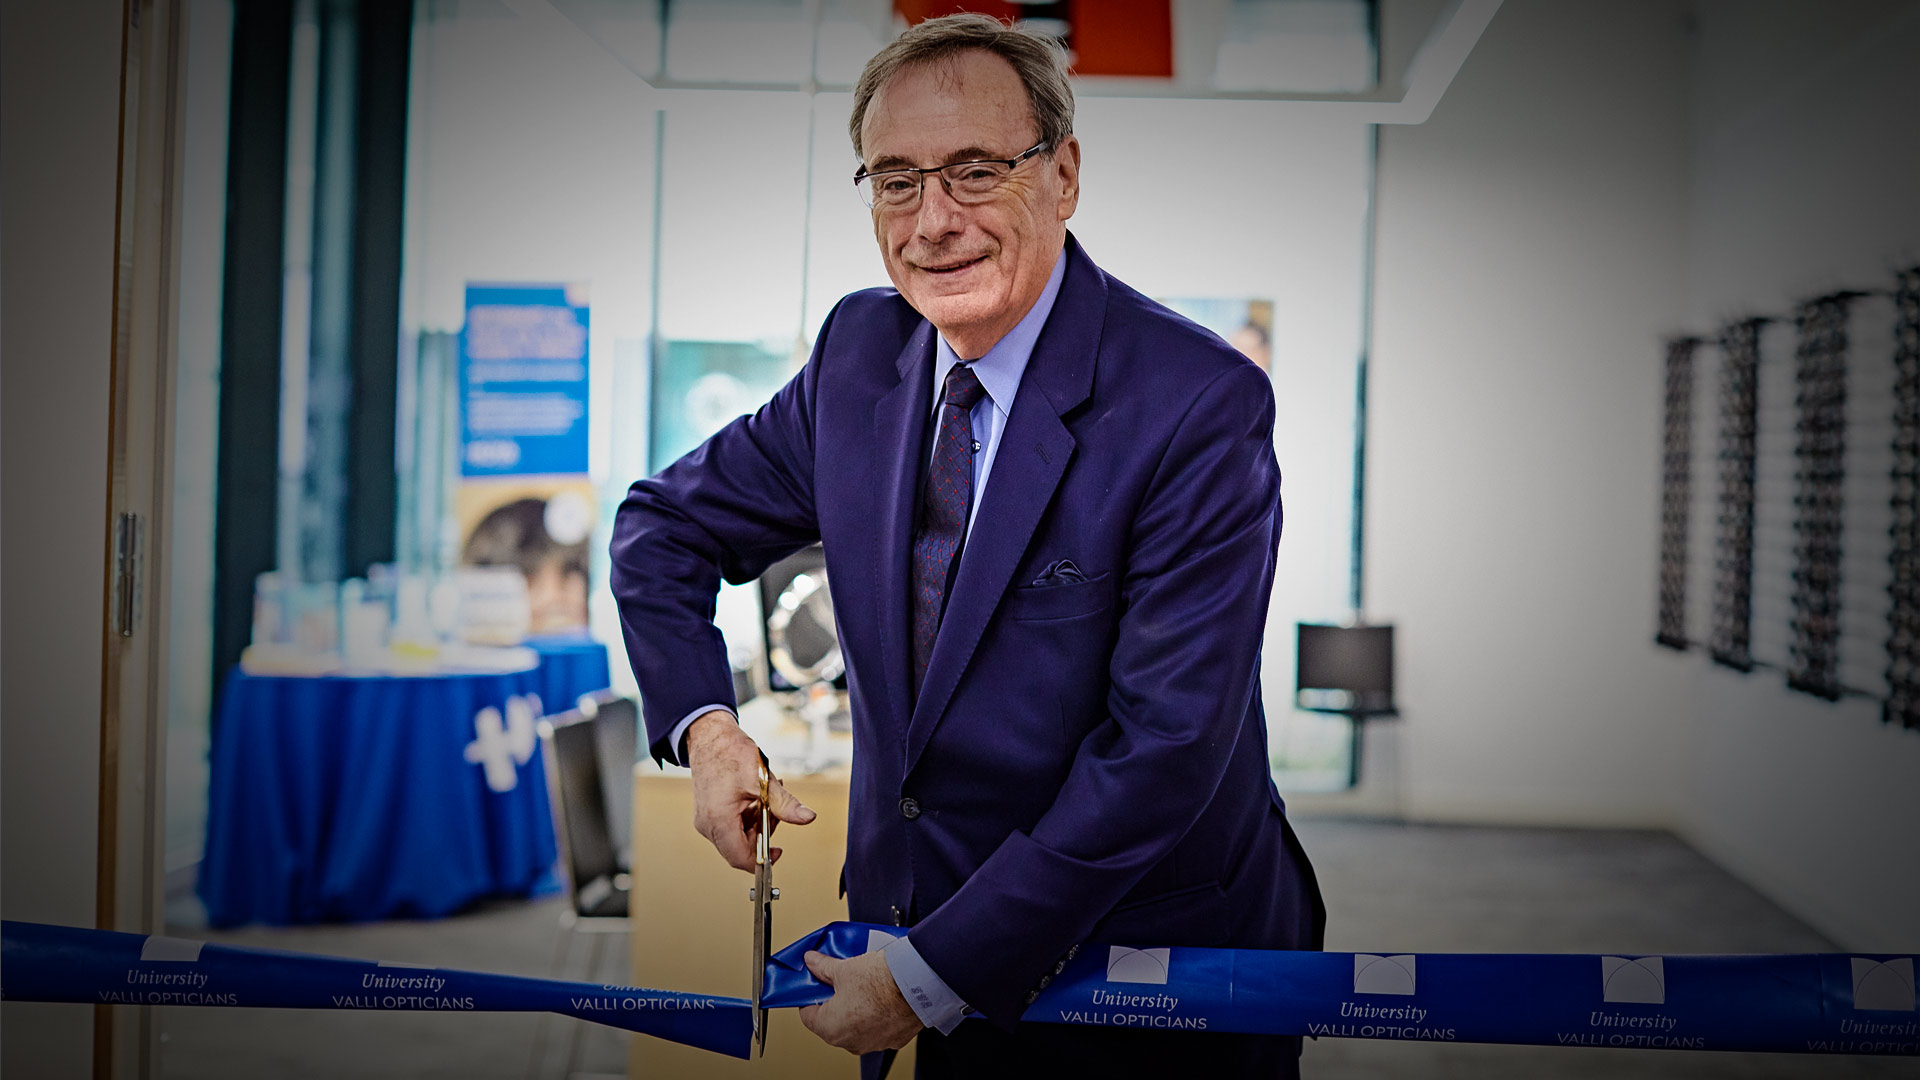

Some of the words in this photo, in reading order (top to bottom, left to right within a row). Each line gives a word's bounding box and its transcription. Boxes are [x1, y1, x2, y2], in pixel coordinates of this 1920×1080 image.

[127, 969, 208, 988] University
[362, 973, 446, 993] University
[98, 990, 143, 1003] VALLI
[147, 991, 238, 1006] OPTICIANS
[332, 995, 378, 1008] VALLI
[382, 996, 475, 1010] OPTICIANS
[570, 997, 617, 1011] VALLI
[621, 997, 716, 1011] OPTICIANS
[1092, 989, 1179, 1012] University
[1060, 1010, 1107, 1025] VALLI
[1112, 1013, 1208, 1030] OPTICIANS
[1340, 1002, 1427, 1023] University
[1590, 1011, 1677, 1032] University
[1308, 1023, 1355, 1036] VALLI
[1360, 1025, 1456, 1040] OPTICIANS
[1840, 1019, 1920, 1040] Universit
[1556, 1032, 1604, 1046] VALLI
[1609, 1034, 1705, 1049] OPTICIANS
[1807, 1040, 1854, 1053] VALLI
